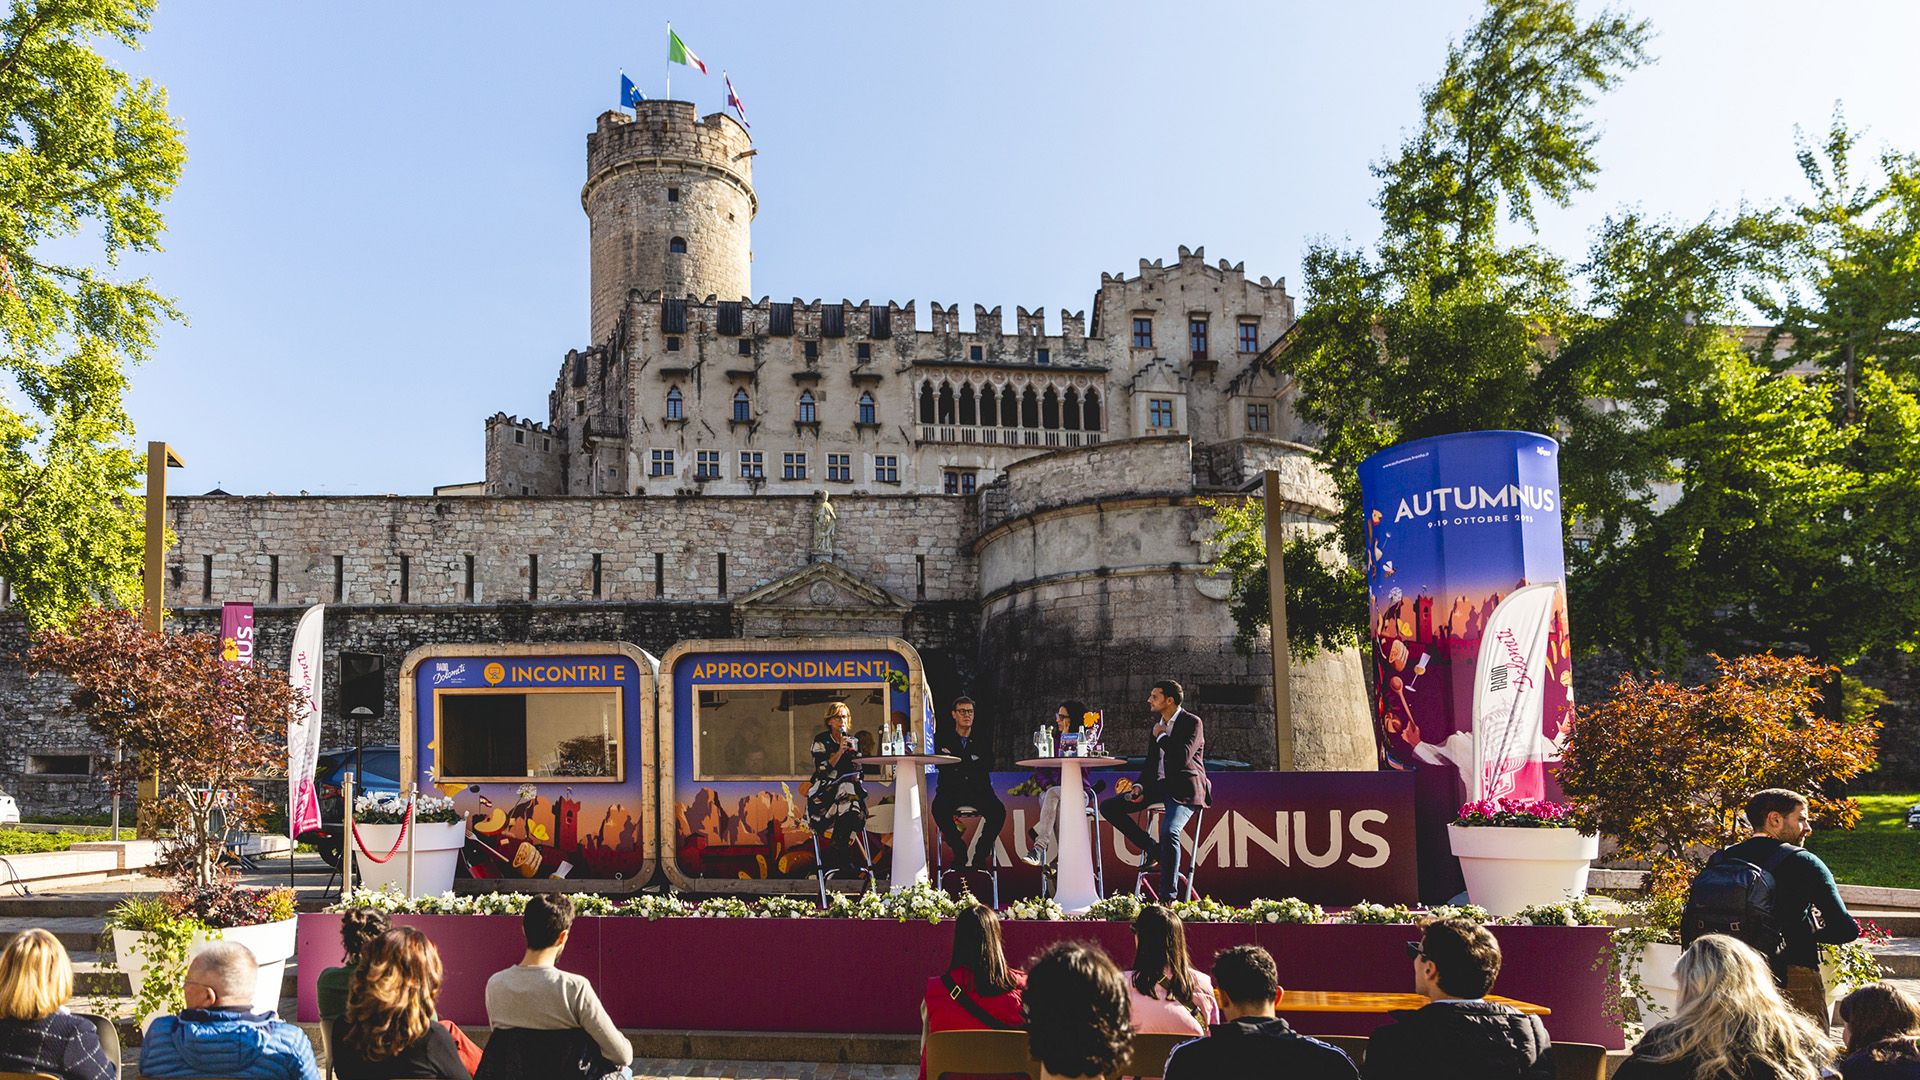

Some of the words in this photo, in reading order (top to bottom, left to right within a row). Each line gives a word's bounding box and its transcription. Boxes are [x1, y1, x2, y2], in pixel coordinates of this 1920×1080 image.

[1394, 484, 1555, 523] AUTUMNUS
[1453, 515, 1508, 525] OTTOBRE
[692, 660, 890, 679] APPROFONDIMENTI
[1496, 628, 1534, 693] Dolomiti
[432, 663, 466, 685] Dolomiti
[511, 665, 606, 682] INCONTRI
[613, 664, 625, 681] E
[1490, 664, 1508, 692] RADIO
